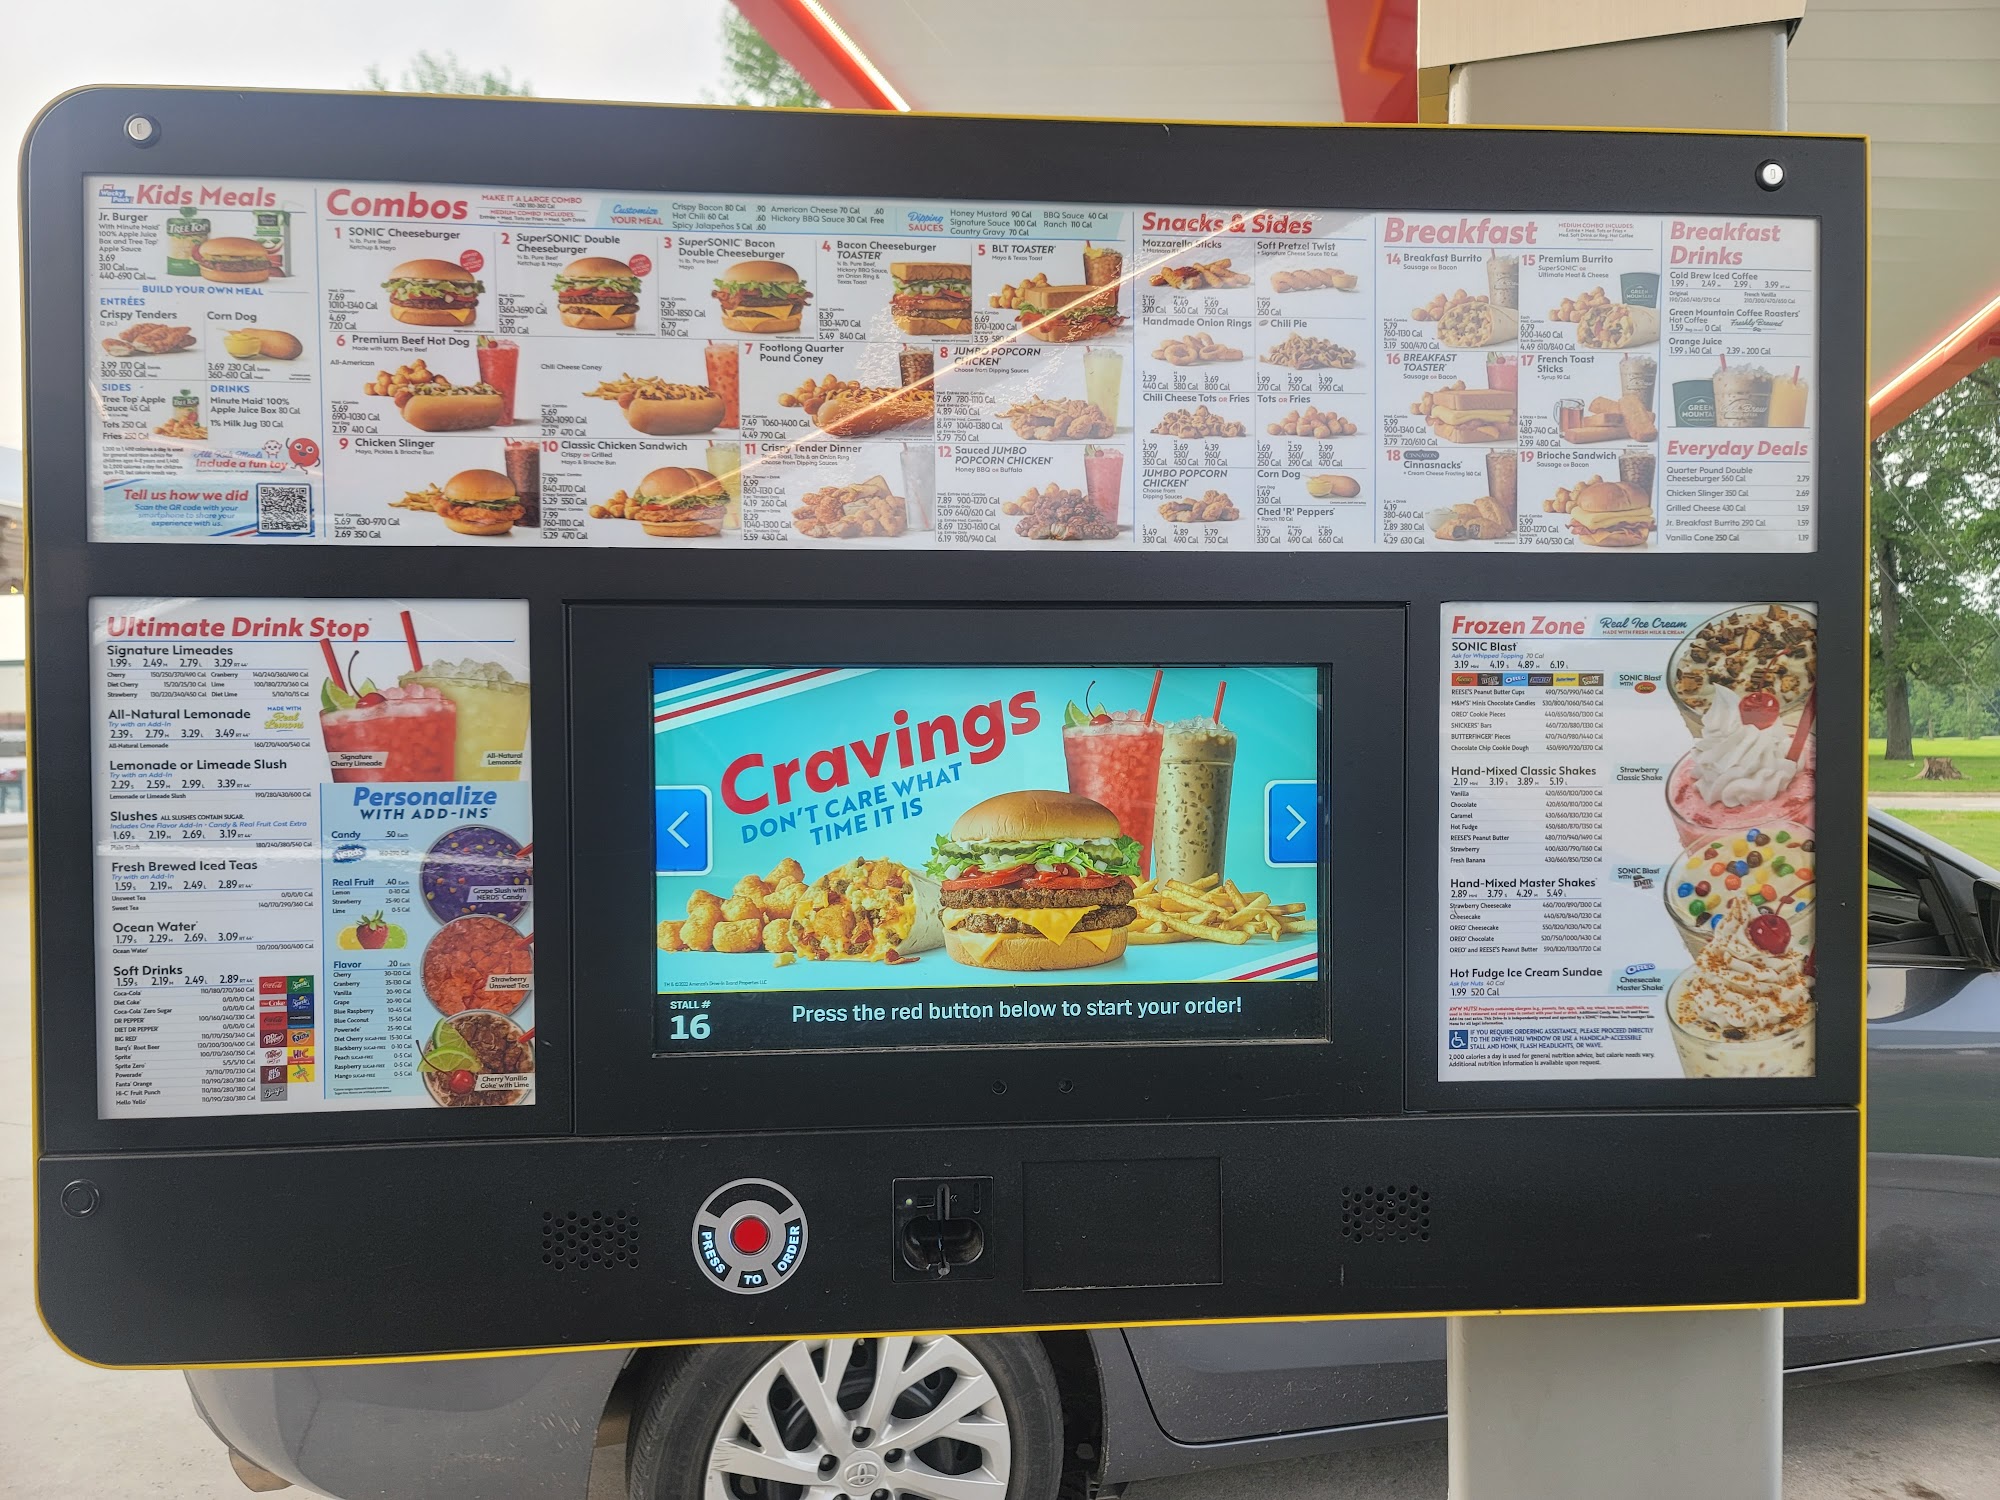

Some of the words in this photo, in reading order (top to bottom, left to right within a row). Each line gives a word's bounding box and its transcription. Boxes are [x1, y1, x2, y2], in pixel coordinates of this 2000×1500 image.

[136, 184, 192, 206] Kids
[200, 186, 276, 207] Meals
[326, 188, 468, 219] Combos
[99, 213, 109, 225] Jr.
[113, 213, 148, 223] Burger
[951, 210, 974, 219] Honey
[1142, 212, 1224, 232] Snacks
[1229, 214, 1246, 232] &
[1252, 214, 1312, 234] Sides
[335, 227, 340, 238] 1
[388, 228, 460, 242] Cheeseburger
[502, 233, 510, 244] 2
[585, 235, 620, 243] Double
[1384, 217, 1538, 248] Breakfast
[1670, 221, 1780, 245] Breakfast
[517, 244, 587, 256] Cheeseburger
[1258, 241, 1276, 249] Soft
[1279, 242, 1309, 251] Pretzel
[1670, 244, 1742, 265] Drinks
[1670, 272, 1688, 281] Cold
[1691, 272, 1711, 281] Brew
[1712, 272, 1730, 281] Iced
[1732, 273, 1758, 282] Coffee
[175, 286, 204, 294] YOUR
[101, 296, 145, 306] ENTRÉES
[100, 310, 133, 322] Crispy
[136, 310, 177, 319] Tenders
[746, 343, 752, 354] 7
[760, 343, 802, 355] Footlong
[805, 344, 844, 352] Quarter
[760, 354, 790, 362] Pound
[794, 353, 823, 364] Coney
[102, 382, 131, 392] SIDES
[211, 385, 250, 393] DRINKS
[340, 438, 348, 449] 9
[355, 438, 396, 450] Chicken
[399, 439, 435, 449] Slinger
[542, 441, 558, 452] 10
[562, 441, 595, 449] Classic
[598, 441, 636, 449] Chicken
[640, 442, 687, 450] Sandwich
[1668, 441, 1754, 459] Everyday
[1758, 441, 1808, 455] Deals
[938, 446, 952, 457] 12
[956, 446, 990, 454] Sauced
[992, 446, 1027, 455] JUMBO
[1520, 451, 1534, 462] 19
[1573, 451, 1616, 459] Sandwich
[956, 456, 1004, 464] POPCORN
[124, 488, 147, 500] Tell
[170, 490, 200, 500] how
[226, 490, 248, 501] did
[1698, 490, 1723, 498] Slinger
[109, 616, 225, 642] Ultimate
[232, 617, 304, 642] Drink
[310, 617, 371, 642] Stop
[1452, 616, 1525, 634] Frozen
[1530, 616, 1586, 634] Zone
[1600, 618, 1629, 628] Real
[1632, 618, 1649, 628] Ice
[1652, 618, 1687, 628] Cream
[108, 646, 168, 658] Signature
[173, 646, 233, 655] Limeades
[108, 710, 180, 719] All-Natural
[184, 709, 250, 719] Lemonade
[721, 691, 1040, 814] Cravings
[110, 760, 176, 770] Lemonade
[197, 760, 250, 769] Limeade
[254, 759, 286, 769] Slush
[1452, 767, 1517, 775] Hand-Mixed
[1521, 766, 1556, 775] Classic
[1559, 766, 1596, 775] Shakes
[352, 786, 497, 808] Personalize
[742, 804, 818, 843] DON'T
[825, 785, 886, 817] CARE
[892, 762, 962, 797] WHAT
[111, 812, 157, 821] Slushes
[360, 809, 404, 820] WITH
[412, 808, 491, 819] ADD-INS
[810, 813, 867, 845] TIME
[874, 805, 895, 827] IT
[903, 798, 923, 819] IS
[332, 831, 361, 841] Candy
[112, 862, 145, 872] Fresh
[149, 861, 196, 871] Brewed
[200, 861, 226, 870] Iced
[229, 860, 257, 870] Teas
[355, 878, 374, 888] Fruit
[1451, 879, 1516, 888] Hand-Mixed
[1520, 879, 1556, 887] Master
[1559, 878, 1595, 887] Shakes
[113, 923, 154, 932] Ocean
[157, 922, 198, 931] Water
[114, 966, 139, 976] Soft
[143, 965, 182, 975] Drinks
[1451, 969, 1469, 977] Hot
[1473, 969, 1504, 979] Fudge
[1508, 968, 1522, 977] Ice
[1525, 968, 1559, 976] Cream
[1563, 967, 1602, 976] Sundae
[1452, 988, 1466, 996] 1.99
[1472, 988, 1484, 996] 520
[1487, 988, 1499, 996] Cal
[670, 1000, 700, 1010] STALL
[701, 1000, 711, 1009] #
[793, 1004, 848, 1023] Press
[852, 1004, 886, 1021] the
[892, 1002, 923, 1020] red
[930, 1001, 992, 1020] button
[999, 1000, 1057, 1018] below
[1062, 1000, 1081, 1017] to
[1086, 999, 1133, 1016] start
[1138, 1001, 1180, 1019] your
[1185, 996, 1242, 1014] order!
[671, 1014, 710, 1040] 16
[702, 1232, 725, 1274] PRESS
[744, 1275, 762, 1284] TO
[778, 1226, 800, 1271] ORDER
